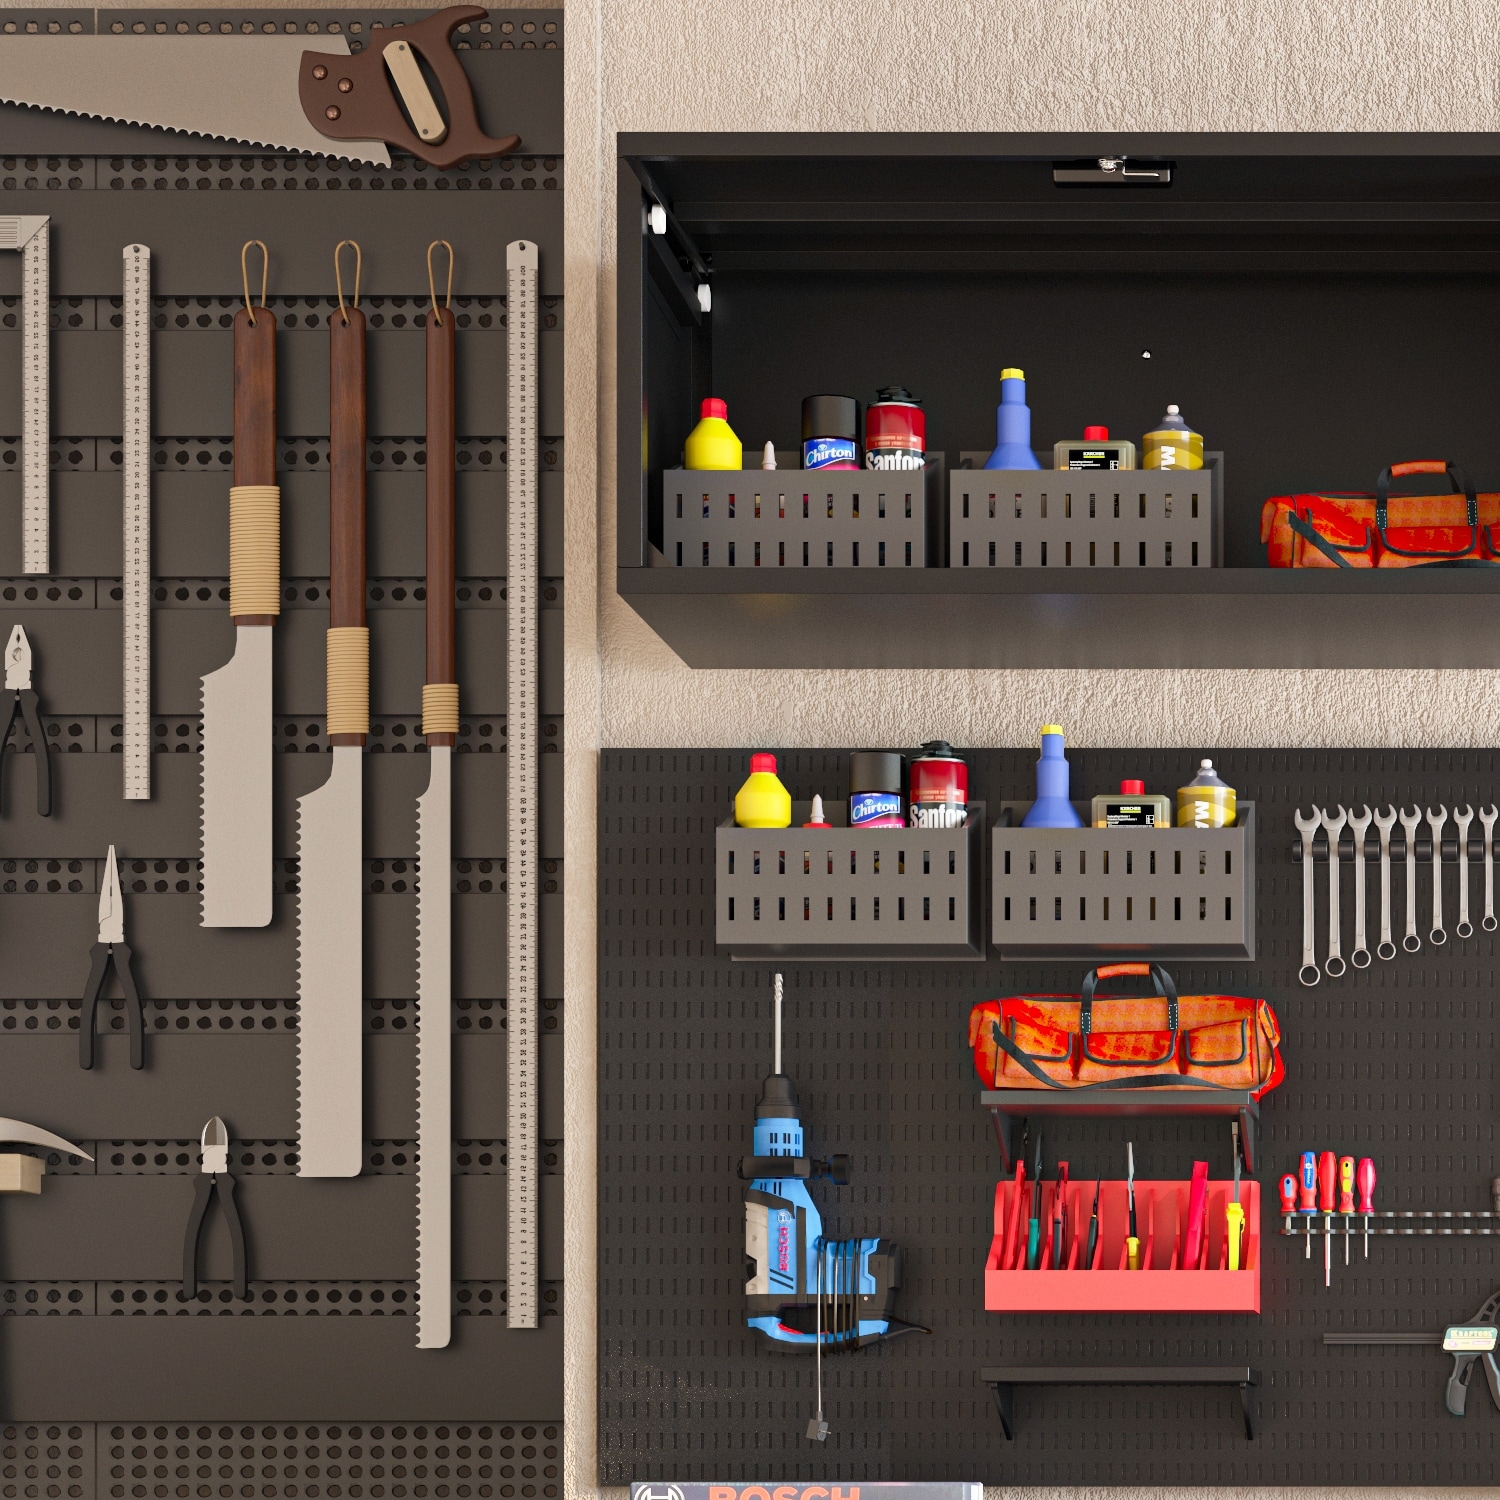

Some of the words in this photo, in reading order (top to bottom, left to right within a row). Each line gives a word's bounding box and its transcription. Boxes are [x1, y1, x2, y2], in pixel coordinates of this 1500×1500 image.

[806, 448, 852, 466] Chirton
[1161, 446, 1175, 470] M
[853, 801, 898, 820] Chirton
[778, 1227, 789, 1272] BOSCH
